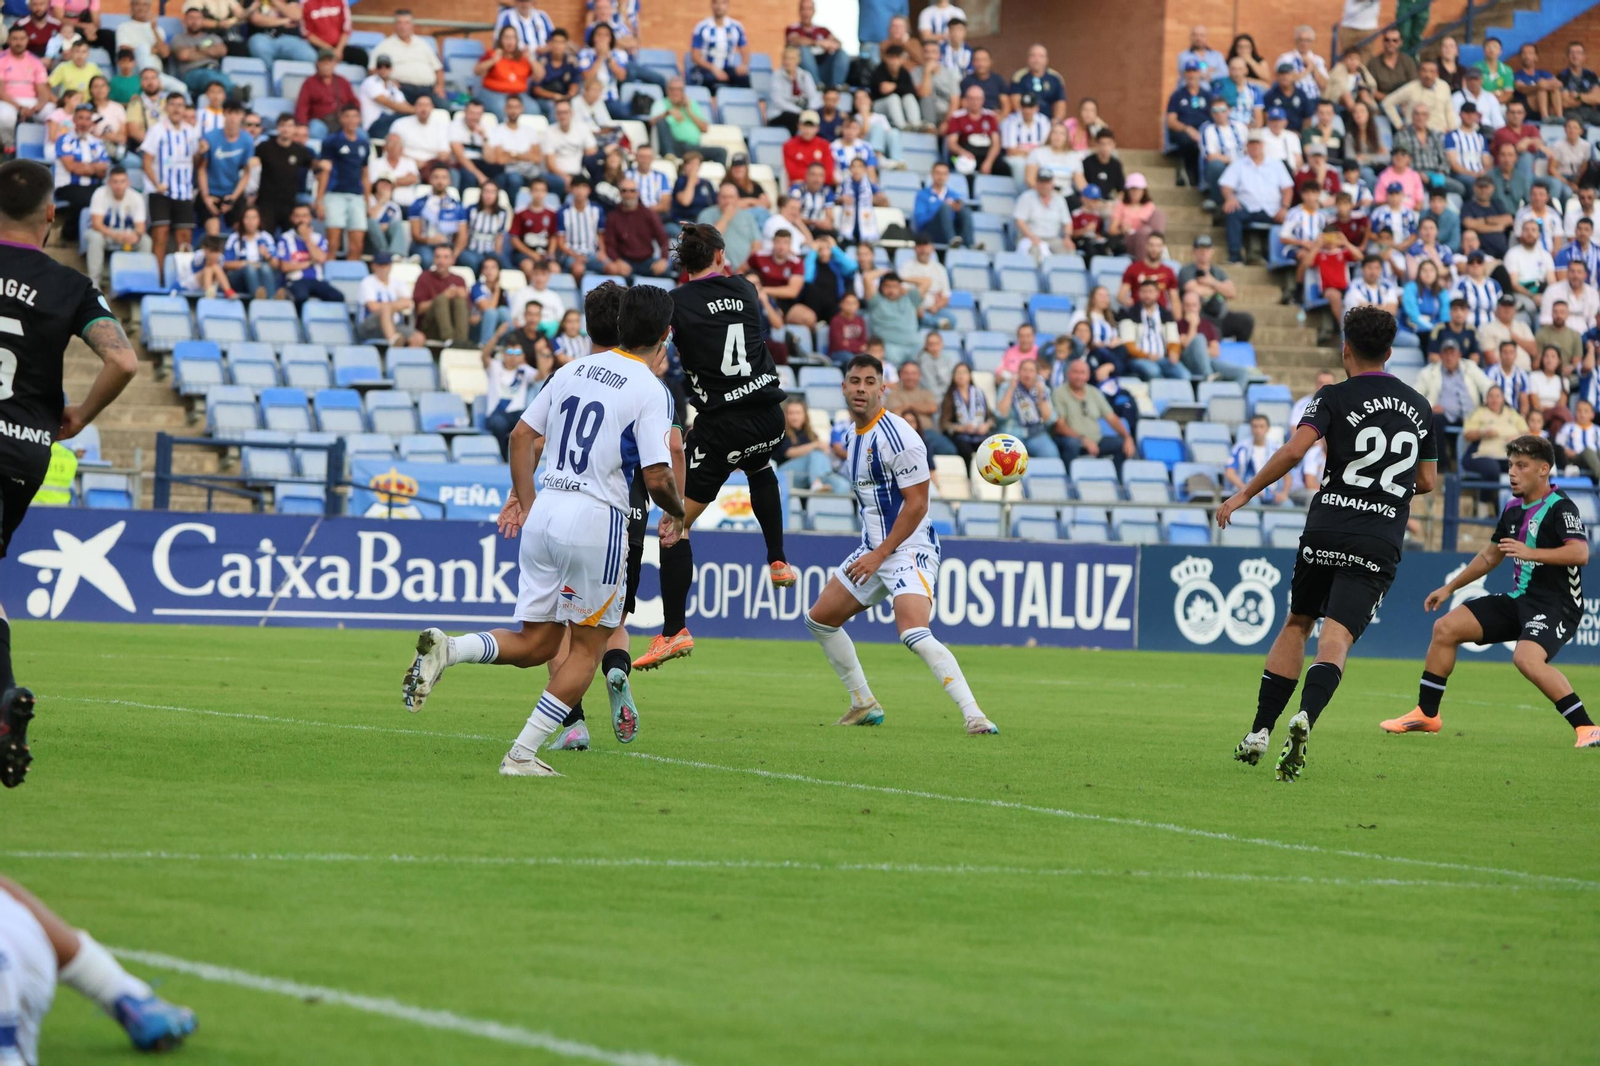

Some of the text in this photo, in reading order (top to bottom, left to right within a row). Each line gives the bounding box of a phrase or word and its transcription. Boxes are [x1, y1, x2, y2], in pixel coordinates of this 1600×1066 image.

[706, 298, 744, 315] RECIO
[720, 322, 753, 377] 4
[586, 364, 628, 390] VIEDMA
[723, 372, 778, 402] BENAHAV
[555, 394, 605, 476] 19
[1346, 396, 1428, 440] M. SANTAELLA
[744, 442, 768, 454] COSTA
[1341, 426, 1419, 499] 22
[438, 483, 502, 507] PEÑA
[152, 522, 517, 604] CaixaBank
[1316, 549, 1347, 561] COSTA
[1348, 554, 1365, 566] DEL
[930, 556, 1134, 631] OSTALUZ
